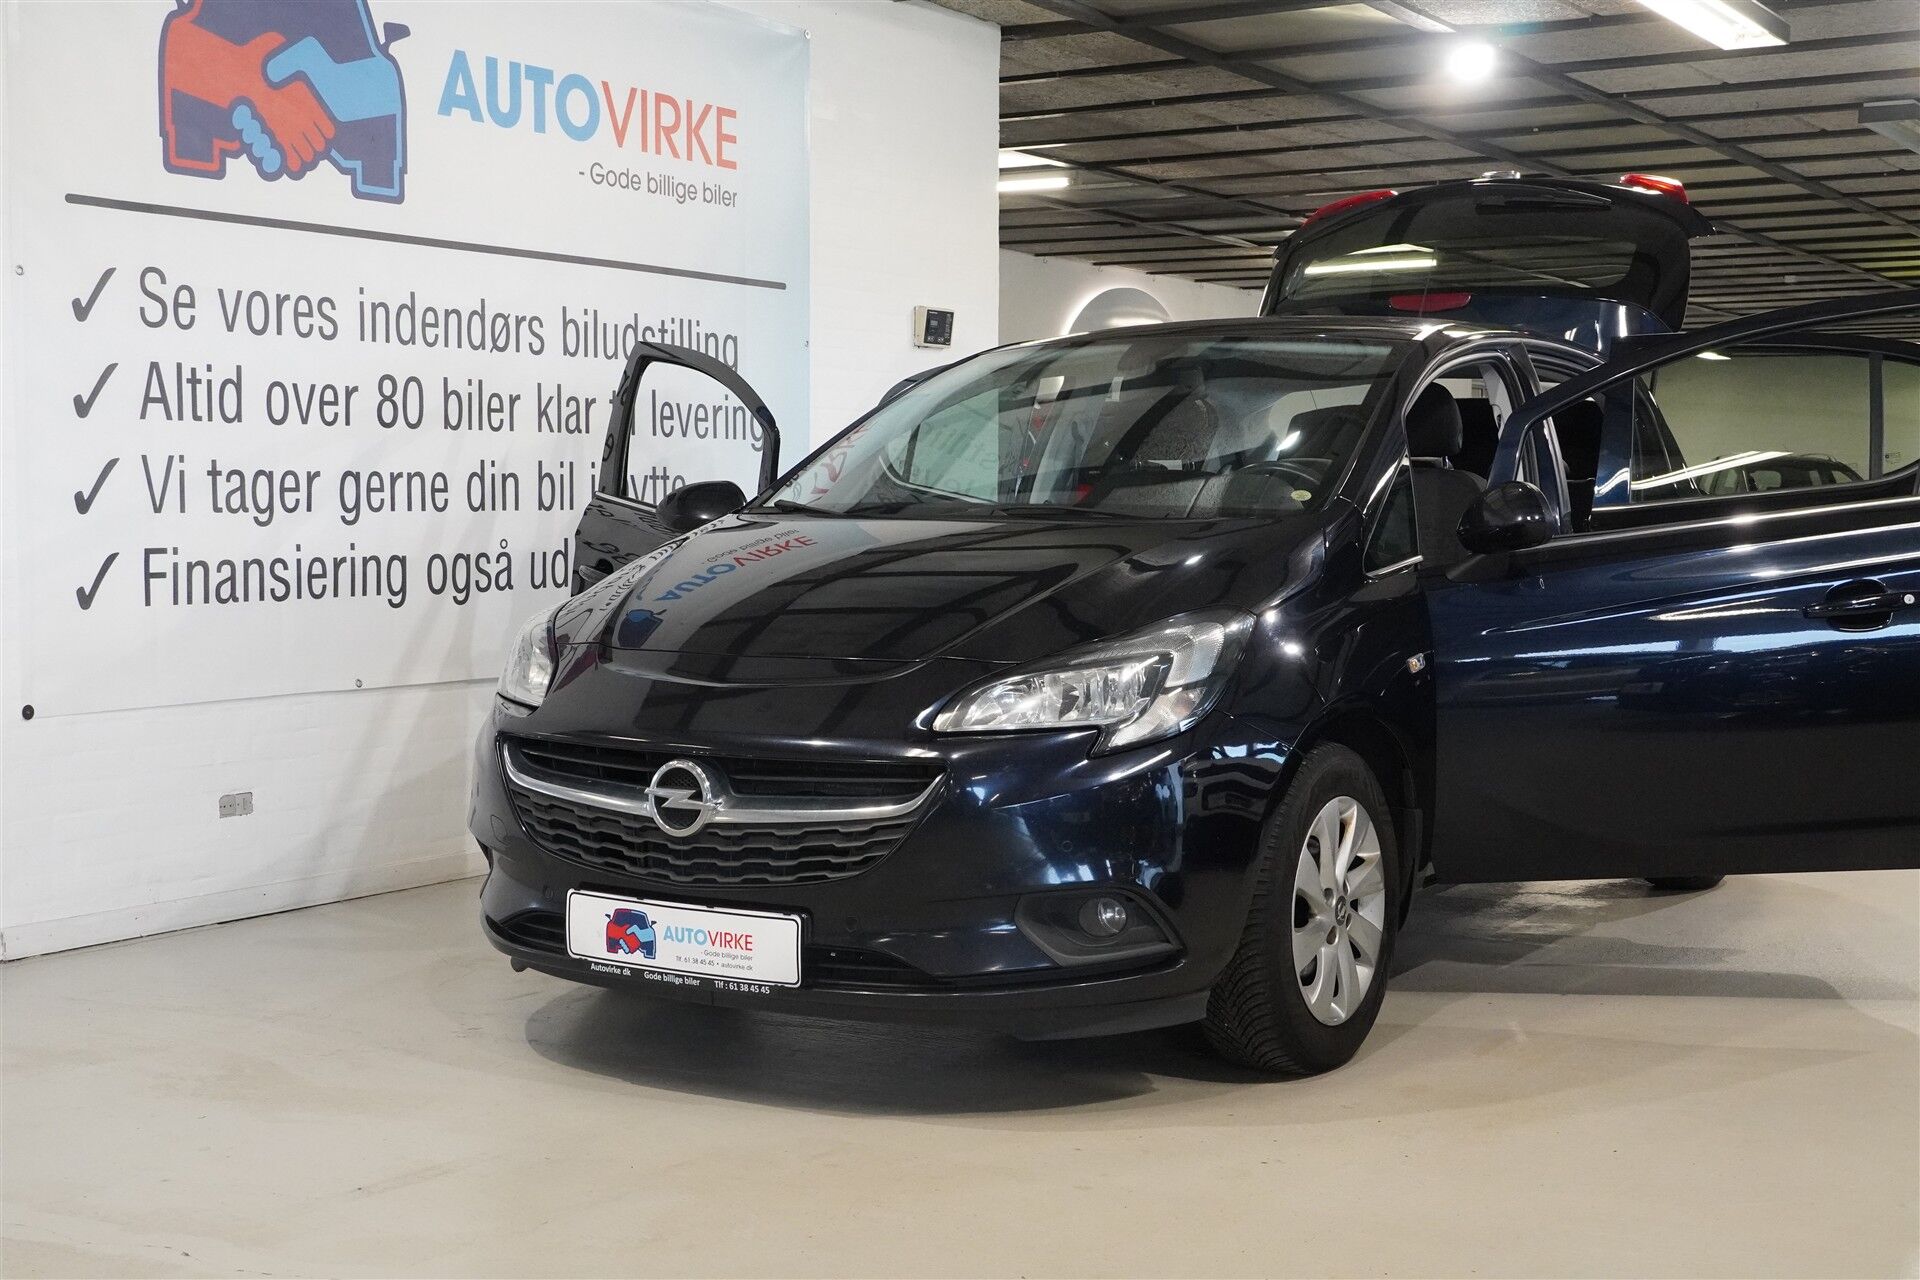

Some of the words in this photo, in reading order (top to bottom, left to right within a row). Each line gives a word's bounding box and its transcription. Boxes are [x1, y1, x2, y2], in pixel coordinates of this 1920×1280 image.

[437, 49, 737, 170] AUTOVIRKE
[590, 162, 641, 191] Gode
[647, 171, 698, 204] billige
[703, 182, 738, 207] biler
[139, 266, 196, 330] Se
[217, 288, 339, 342] vores
[359, 287, 545, 356] indendørs
[139, 361, 243, 424] Altid
[266, 379, 359, 428] over
[376, 373, 424, 430] 80
[443, 376, 521, 433] biler
[537, 382, 597, 435] klar
[651, 388, 764, 451] levering
[141, 455, 186, 514] Vi
[206, 459, 321, 528] tager
[339, 470, 449, 526] gerne
[466, 460, 520, 514] din
[537, 460, 575, 514] bil
[143, 546, 407, 609] Finansiering
[426, 539, 514, 605] også
[663, 925, 753, 951] AUTOVIRKE
[704, 949, 721, 957] Gode
[721, 952, 739, 960] billige
[643, 971, 662, 981] Gode
[662, 974, 683, 984] billige
[684, 976, 700, 986] biler
[714, 981, 724, 989] Tlf
[729, 983, 739, 991] 61
[740, 984, 749, 992] 38
[750, 985, 760, 993] 45
[760, 986, 770, 994] 45
